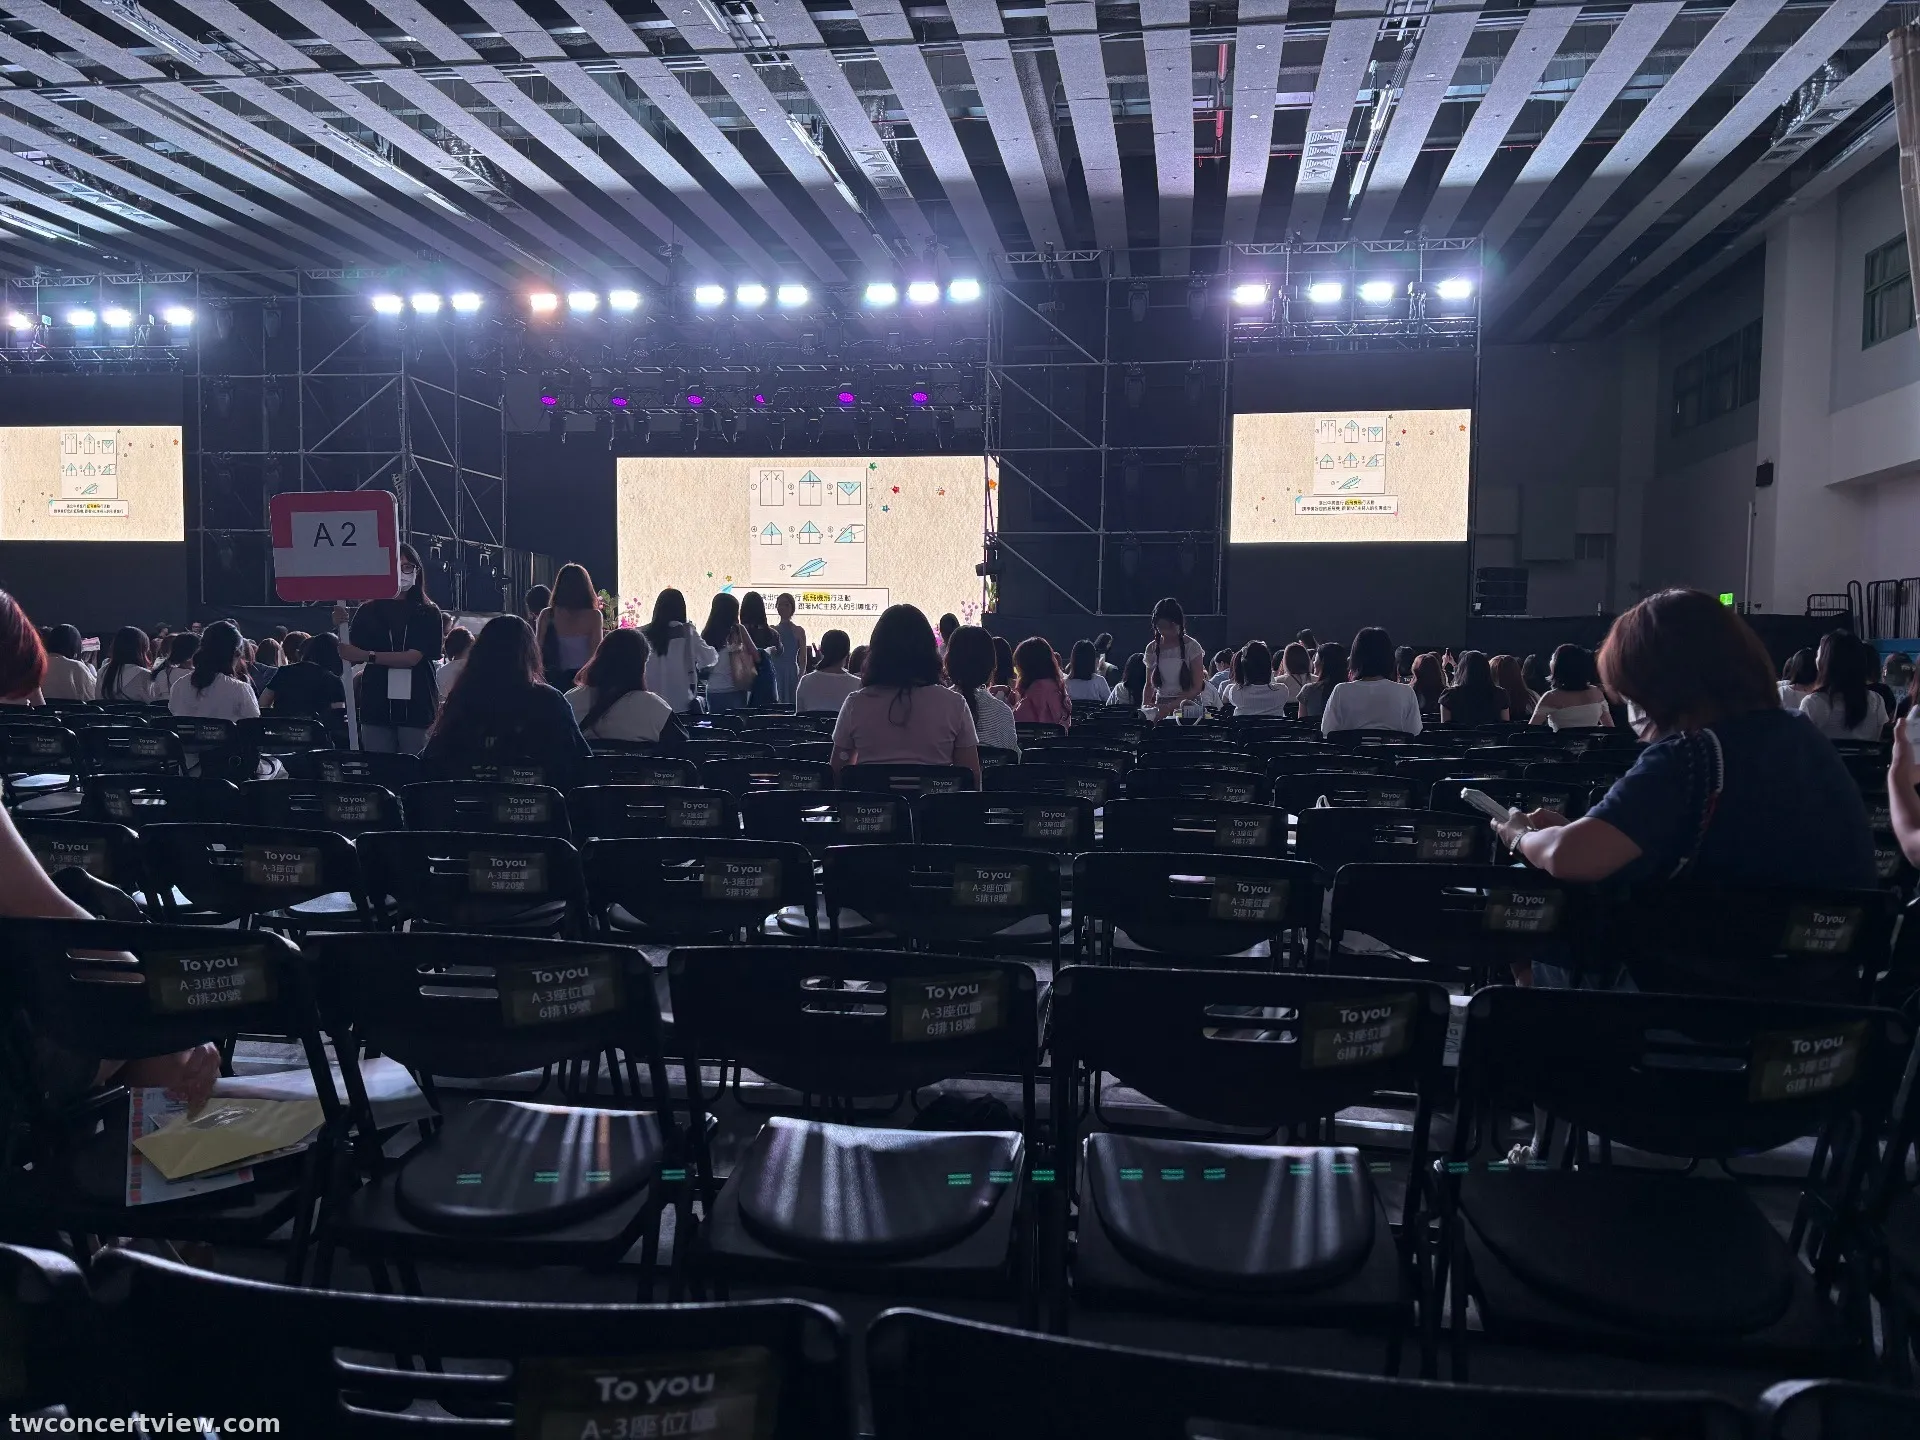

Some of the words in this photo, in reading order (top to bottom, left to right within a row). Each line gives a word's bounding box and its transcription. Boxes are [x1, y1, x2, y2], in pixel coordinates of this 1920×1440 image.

[313, 522, 357, 547] A2
[1446, 831, 1463, 839] you
[52, 841, 65, 850] To
[67, 842, 89, 852] you
[264, 850, 277, 860] To
[280, 852, 301, 862] you
[490, 858, 503, 867] To
[505, 859, 527, 868] you
[726, 864, 739, 873] To
[741, 865, 762, 875] you
[977, 870, 990, 879] To
[991, 871, 1011, 880] you
[1236, 883, 1250, 893] To
[1251, 884, 1271, 894] you
[1511, 893, 1526, 904] To
[1526, 895, 1545, 905] you
[1813, 913, 1826, 923] To
[1826, 915, 1847, 924] you
[180, 959, 200, 973] To
[204, 956, 239, 973] you
[532, 971, 553, 984] To
[555, 966, 590, 983] you
[925, 986, 945, 999] To
[947, 983, 979, 1000] you
[1340, 1010, 1359, 1024] To
[1361, 1006, 1392, 1023] you
[1792, 1040, 1811, 1054] To
[1813, 1036, 1843, 1054] you
[595, 1376, 639, 1404] To
[644, 1372, 715, 1405] you
